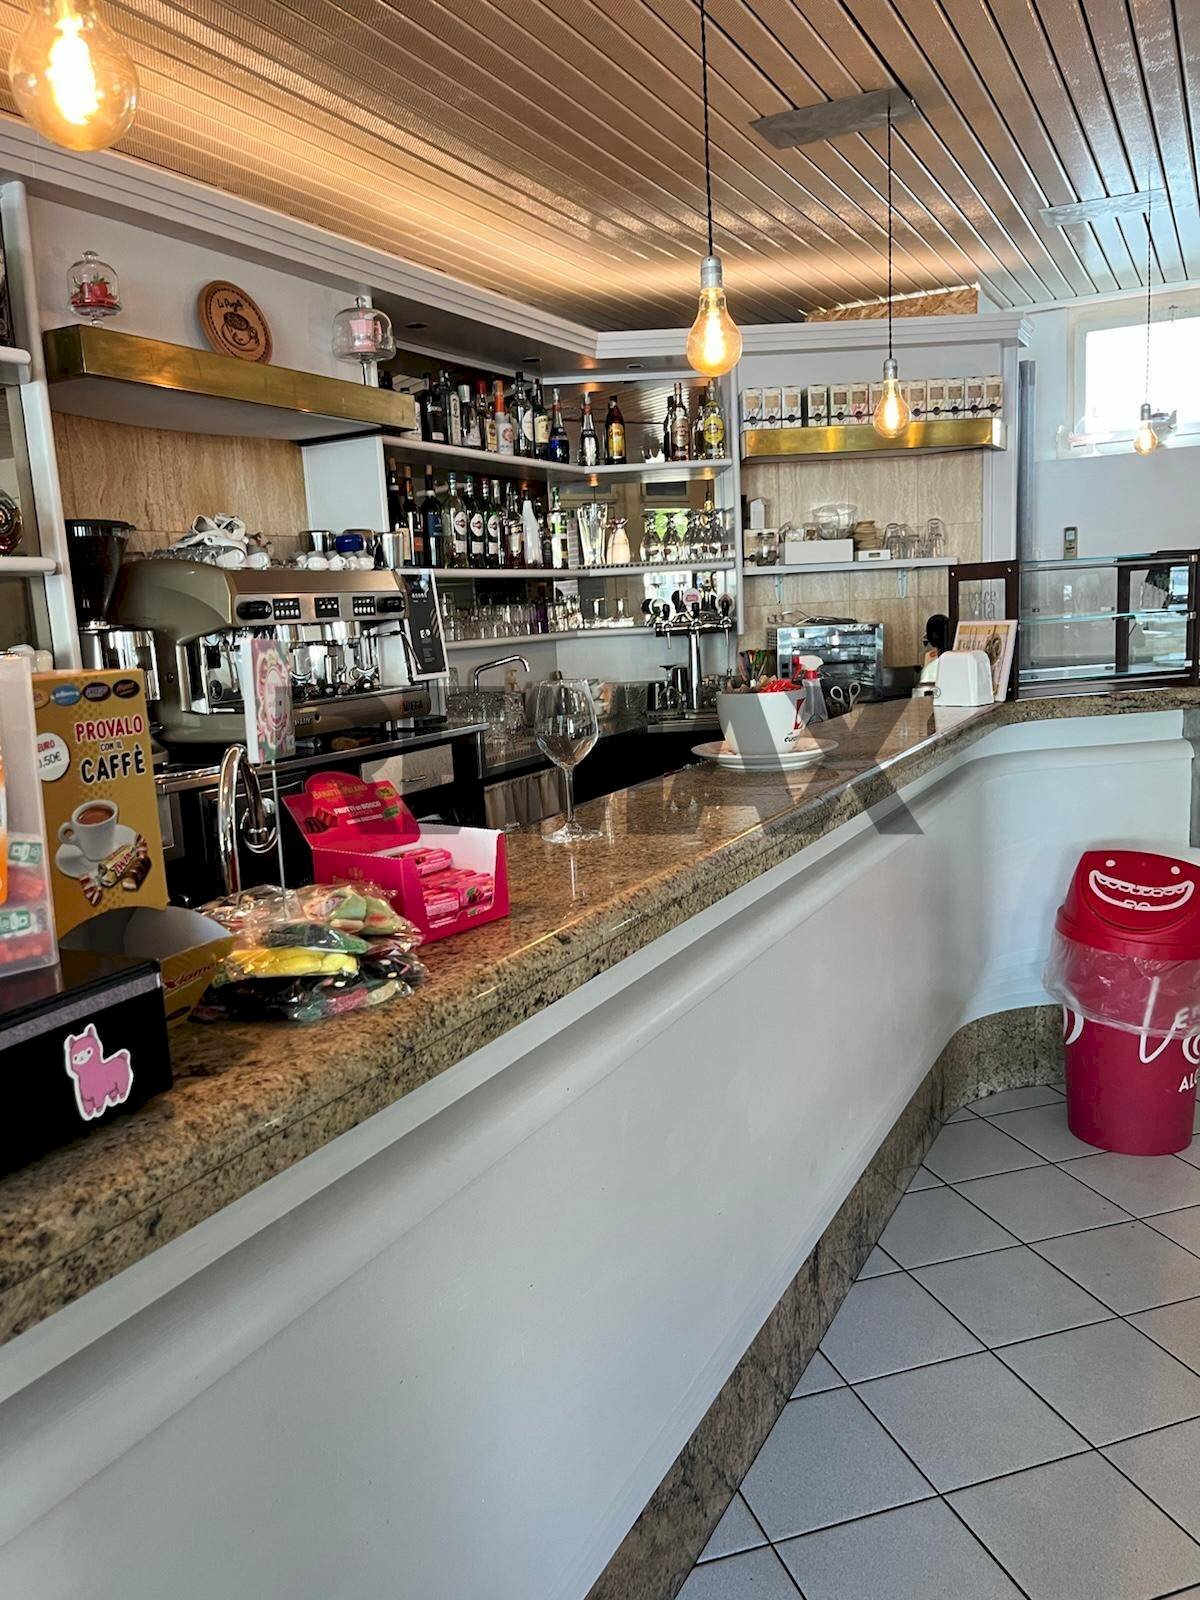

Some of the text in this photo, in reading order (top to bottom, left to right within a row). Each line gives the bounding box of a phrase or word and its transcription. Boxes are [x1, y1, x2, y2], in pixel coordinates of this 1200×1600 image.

[75, 715, 143, 743] PROVALO
[100, 743, 114, 752] CON
[82, 744, 146, 783] CAFFÈ
